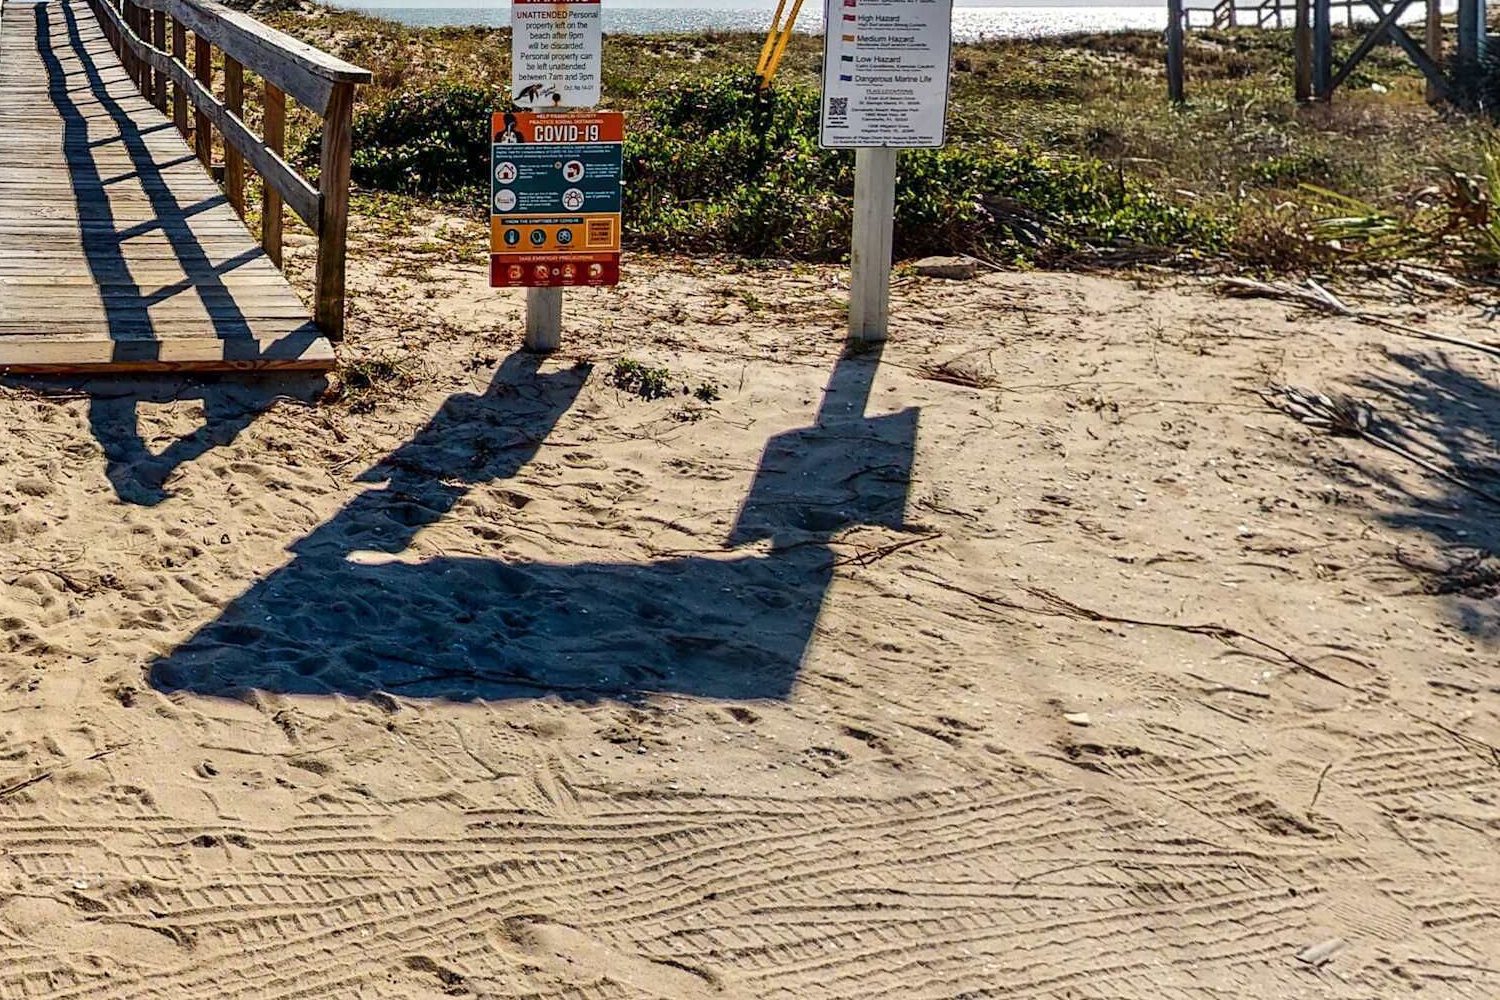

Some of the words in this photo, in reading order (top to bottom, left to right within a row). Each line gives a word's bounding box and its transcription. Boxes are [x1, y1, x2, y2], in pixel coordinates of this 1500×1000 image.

[516, 11, 567, 19] UNATTENDED
[568, 11, 598, 19] Personal
[858, 15, 874, 23] High
[525, 22, 553, 31] property
[529, 31, 550, 39] beach
[551, 31, 567, 39] after
[528, 42, 539, 50] will
[540, 42, 549, 50] be
[520, 52, 550, 60] Personal
[551, 53, 578, 62] property
[526, 62, 536, 70] be
[537, 62, 547, 70] left
[548, 62, 586, 70] unattended
[518, 73, 548, 81] between
[549, 73, 563, 81] 7am
[564, 73, 578, 81] and
[855, 75, 893, 83] Dangerous
[894, 75, 918, 83] Marine
[919, 75, 932, 83] Life
[534, 125, 599, 142] COVID-19
